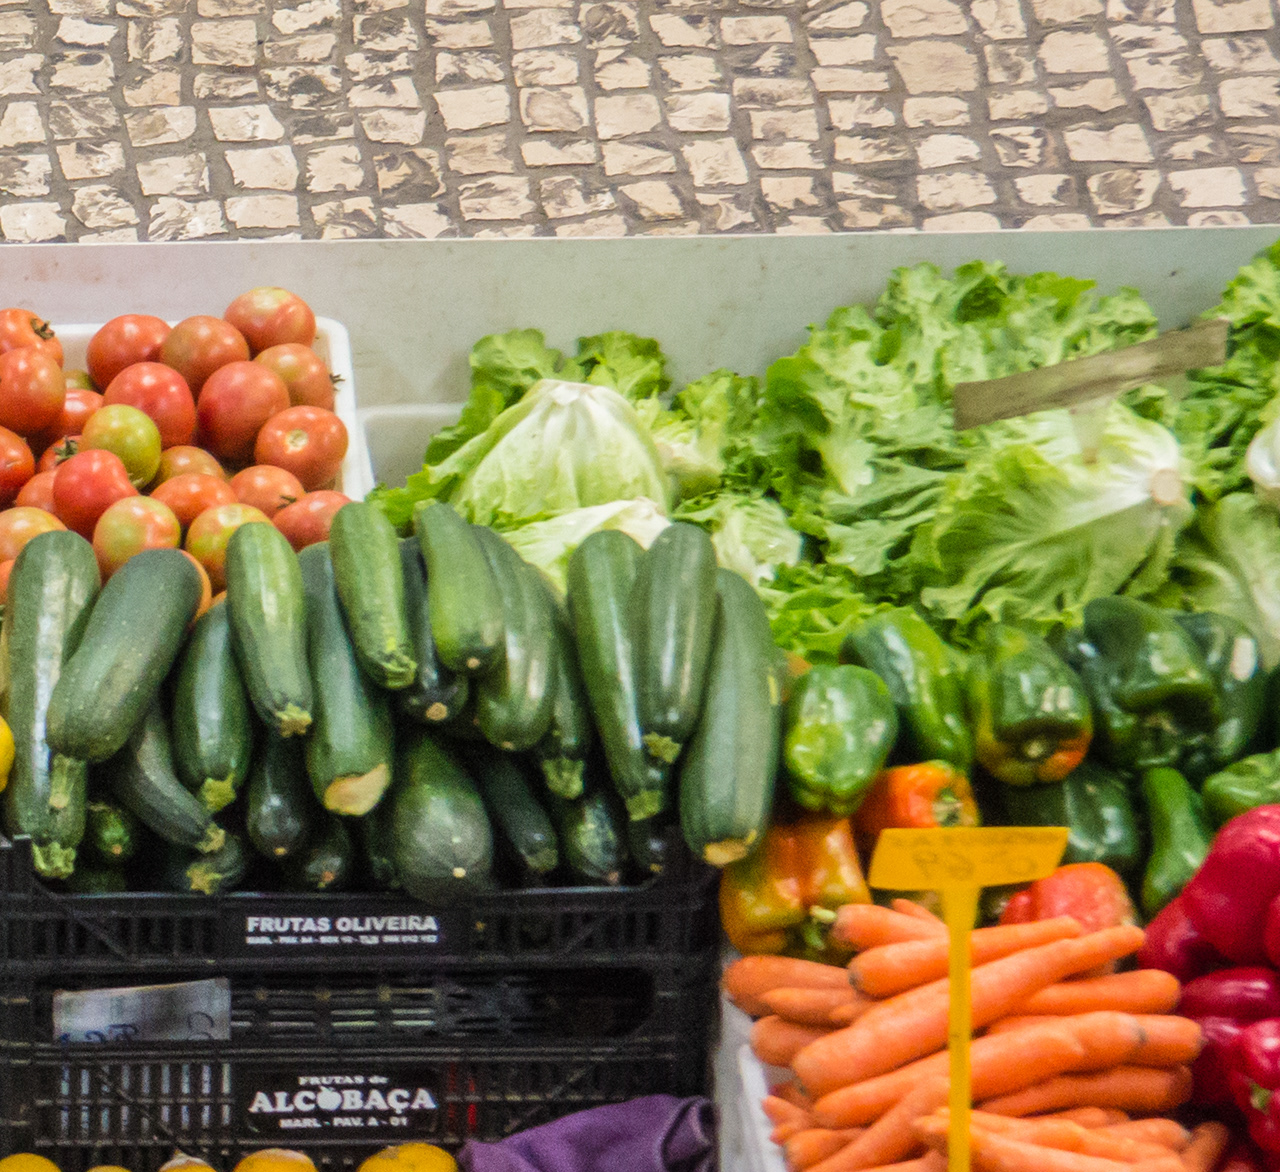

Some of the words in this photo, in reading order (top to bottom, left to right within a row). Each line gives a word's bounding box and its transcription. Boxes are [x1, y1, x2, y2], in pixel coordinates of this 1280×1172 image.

[246, 916, 332, 932] FRUTAS
[335, 914, 439, 931] OLIVEIRA
[298, 1075, 366, 1085] FRUTAS
[248, 1085, 439, 1114] ALCOBAÇA
[279, 1118, 322, 1128] MARL
